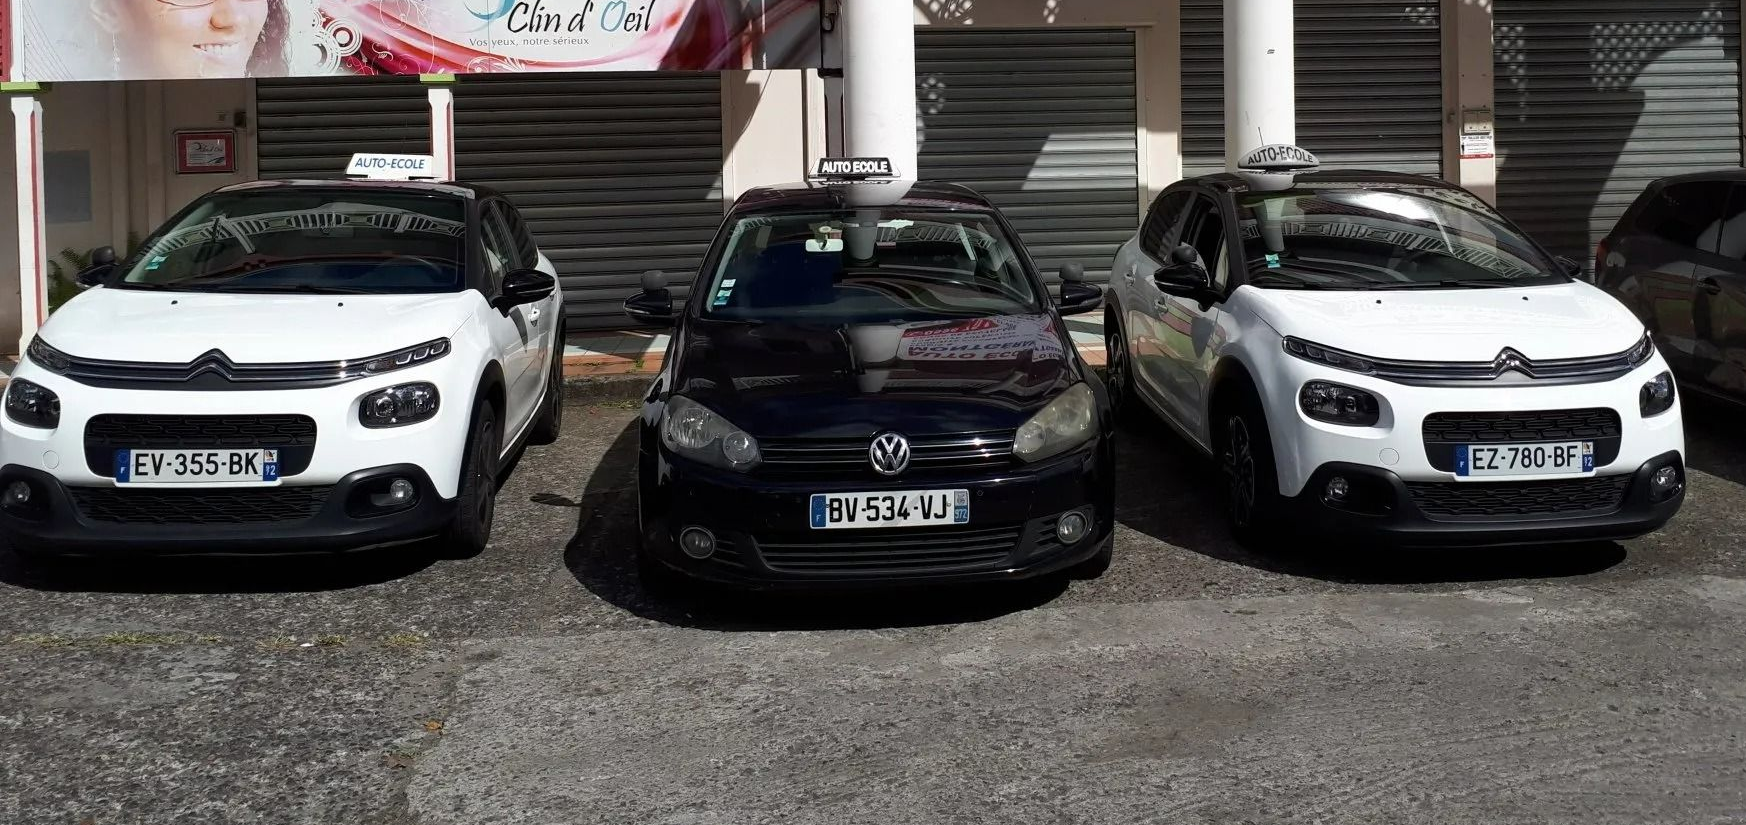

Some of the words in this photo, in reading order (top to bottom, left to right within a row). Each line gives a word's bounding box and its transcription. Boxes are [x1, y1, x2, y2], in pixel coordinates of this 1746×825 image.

[507, 0, 562, 33] Clin
[600, 0, 655, 33] Oeil
[469, 38, 488, 47] Vos
[491, 38, 519, 48] yeux,
[523, 37, 550, 46] notre
[552, 36, 590, 46] sérieux
[354, 157, 426, 169] AUTO-ECOLE
[1247, 146, 1314, 165] AUTO-ECOLE
[821, 161, 851, 173] AUTO
[852, 161, 889, 173] ECOLE
[134, 452, 259, 476] EV-355-BK
[1472, 445, 1578, 470] EZ-780-BF
[829, 494, 947, 523] BV-534-VJ
